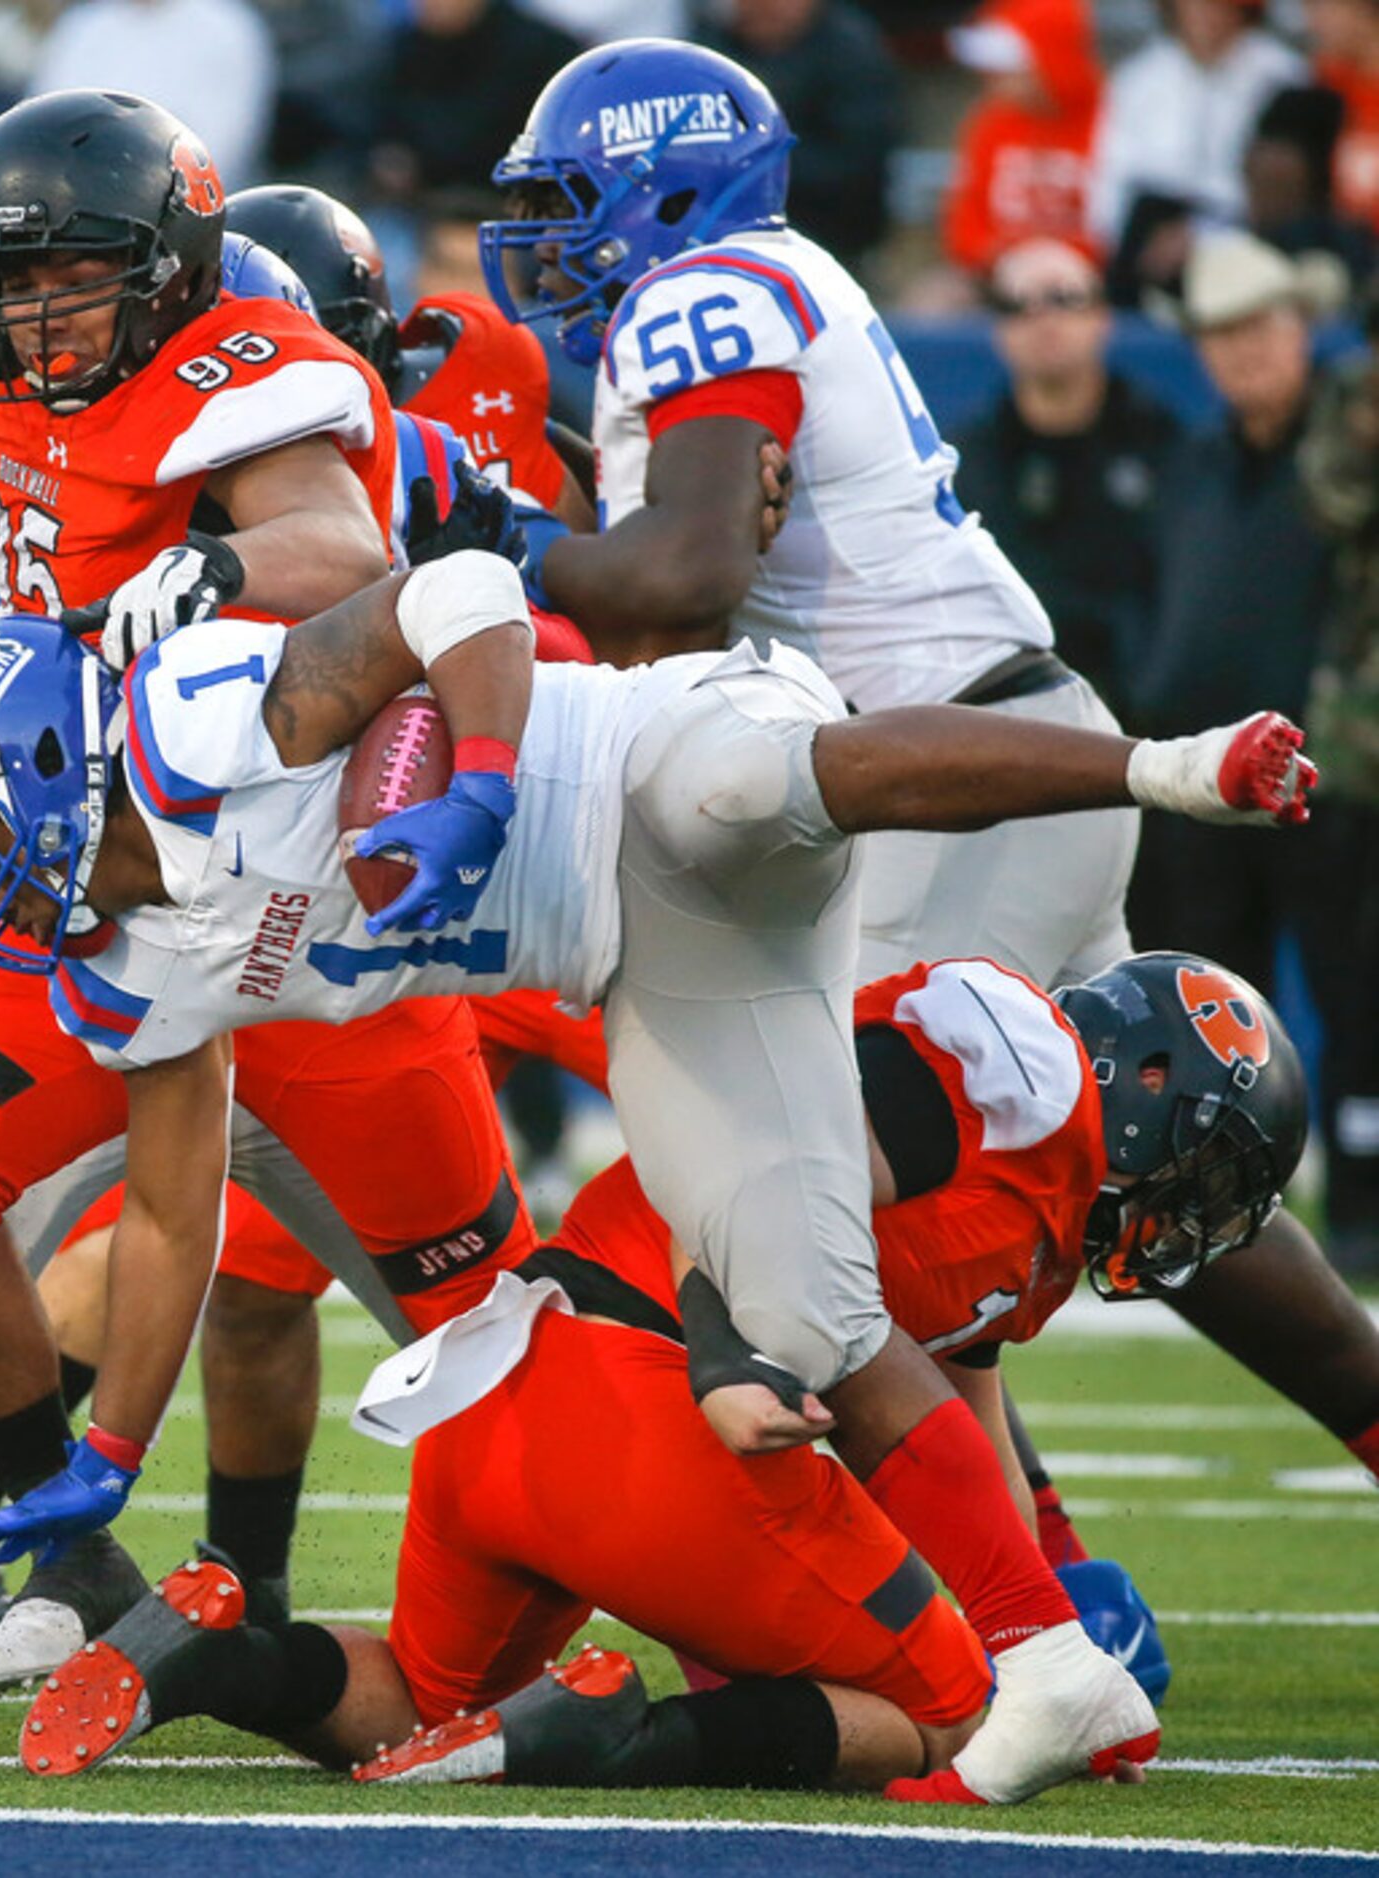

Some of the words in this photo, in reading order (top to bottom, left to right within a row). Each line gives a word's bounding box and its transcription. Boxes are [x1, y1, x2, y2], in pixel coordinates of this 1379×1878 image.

[173, 330, 280, 393] 95
[636, 293, 754, 399] 56
[176, 653, 266, 702] 1
[236, 891, 311, 1002] PANTHERS
